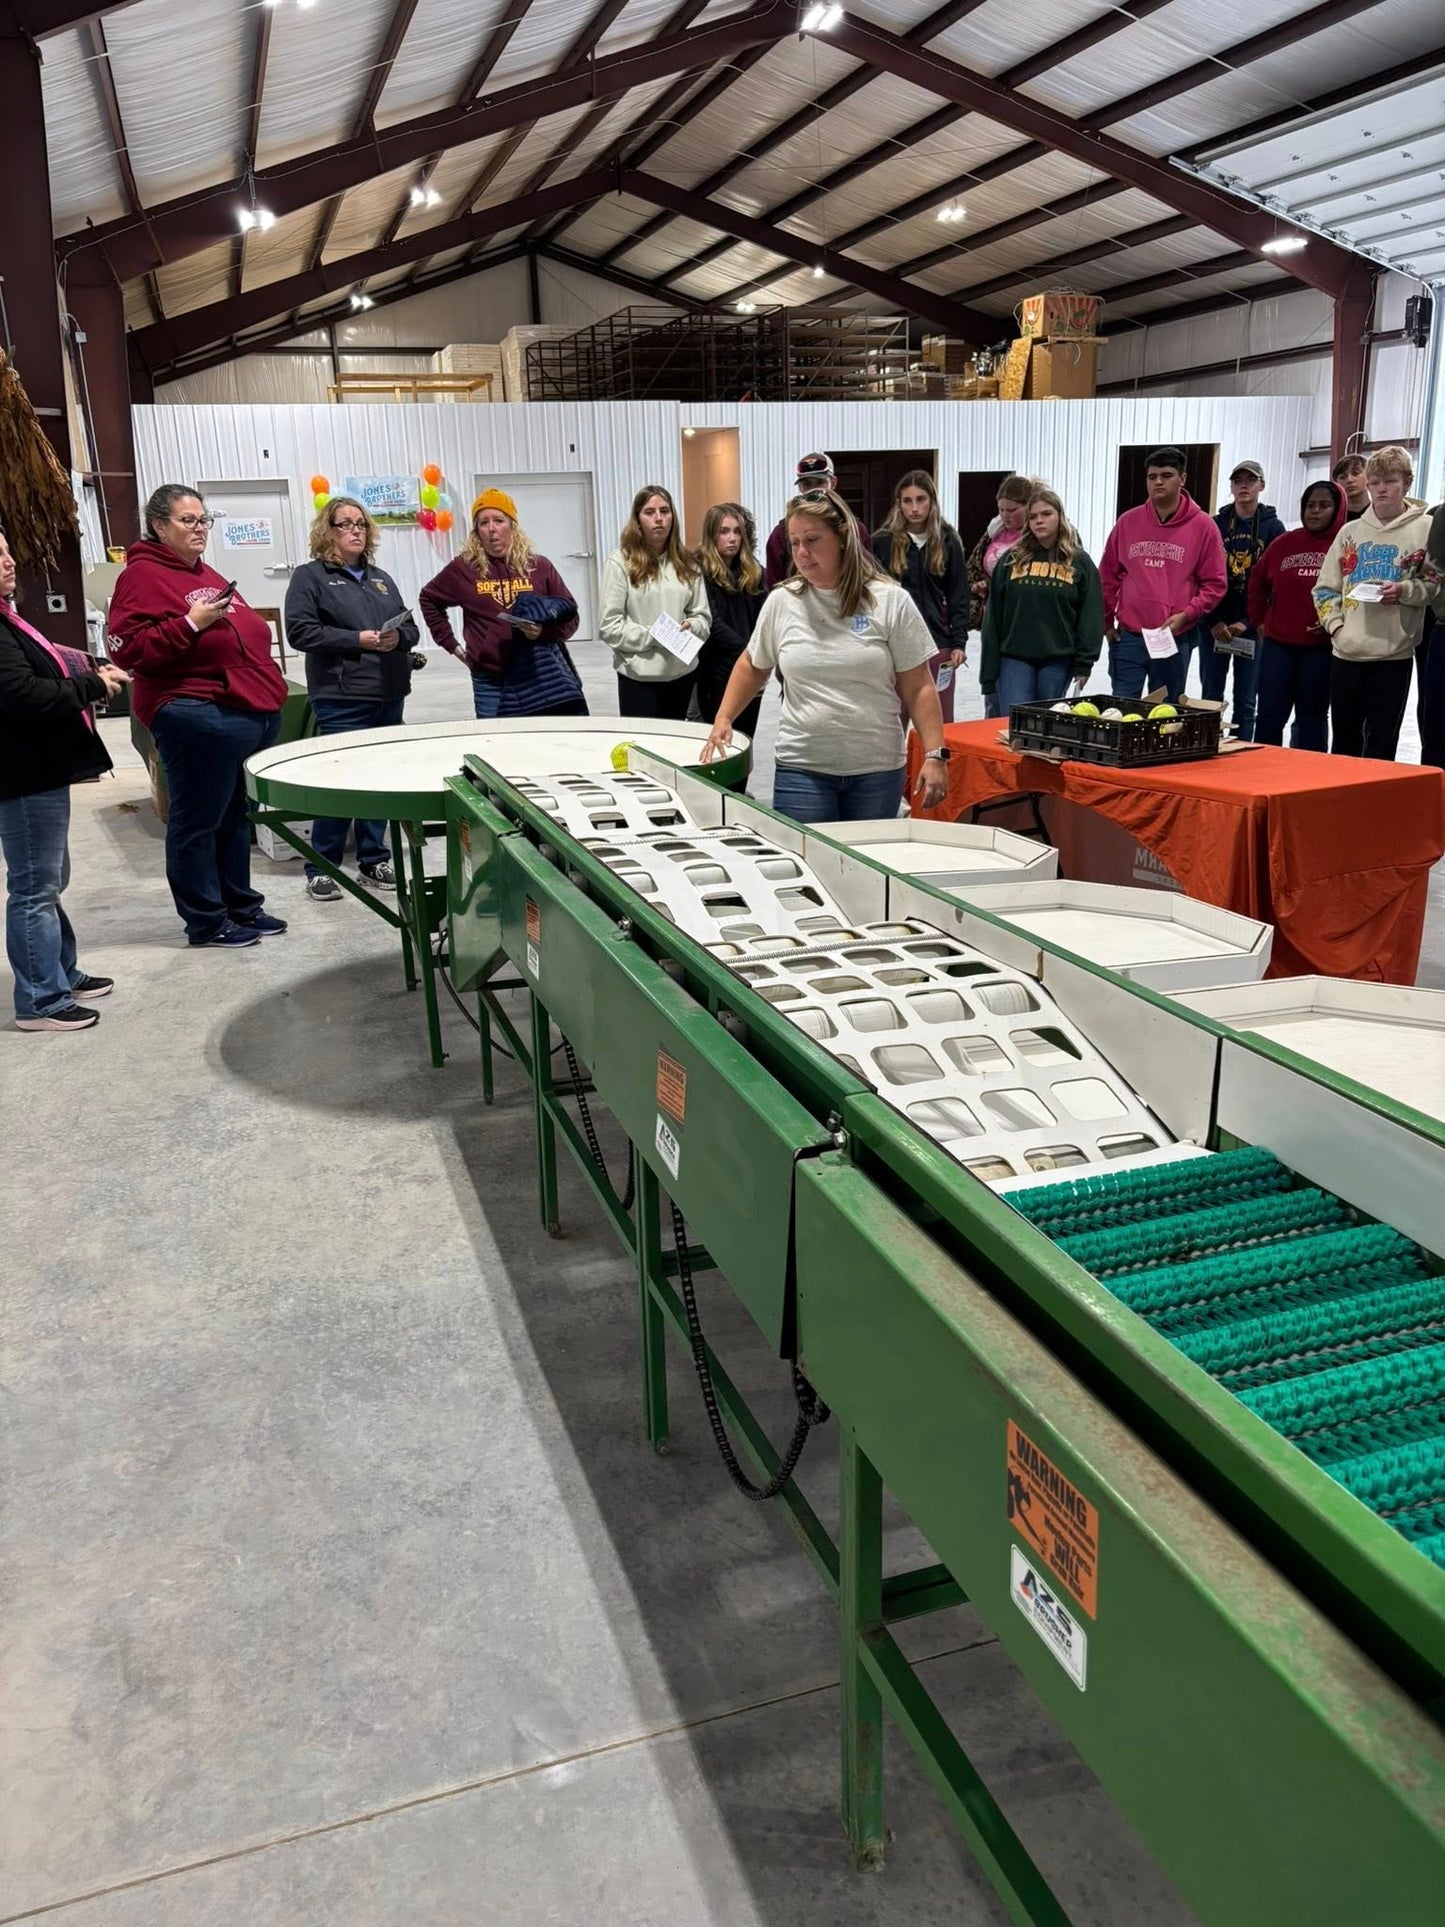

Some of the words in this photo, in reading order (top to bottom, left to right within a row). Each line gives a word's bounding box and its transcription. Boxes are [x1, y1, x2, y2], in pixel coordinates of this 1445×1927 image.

[361, 484, 391, 499] JONES
[365, 490, 406, 507] BROTHERS
[225, 523, 256, 538] JONES
[229, 529, 270, 545] BROTHERS
[1144, 559, 1165, 568] CAMP
[1016, 1430, 1087, 1528] WARNING
[1054, 1537, 1079, 1584] WILL
[1019, 1569, 1072, 1635] AZS
